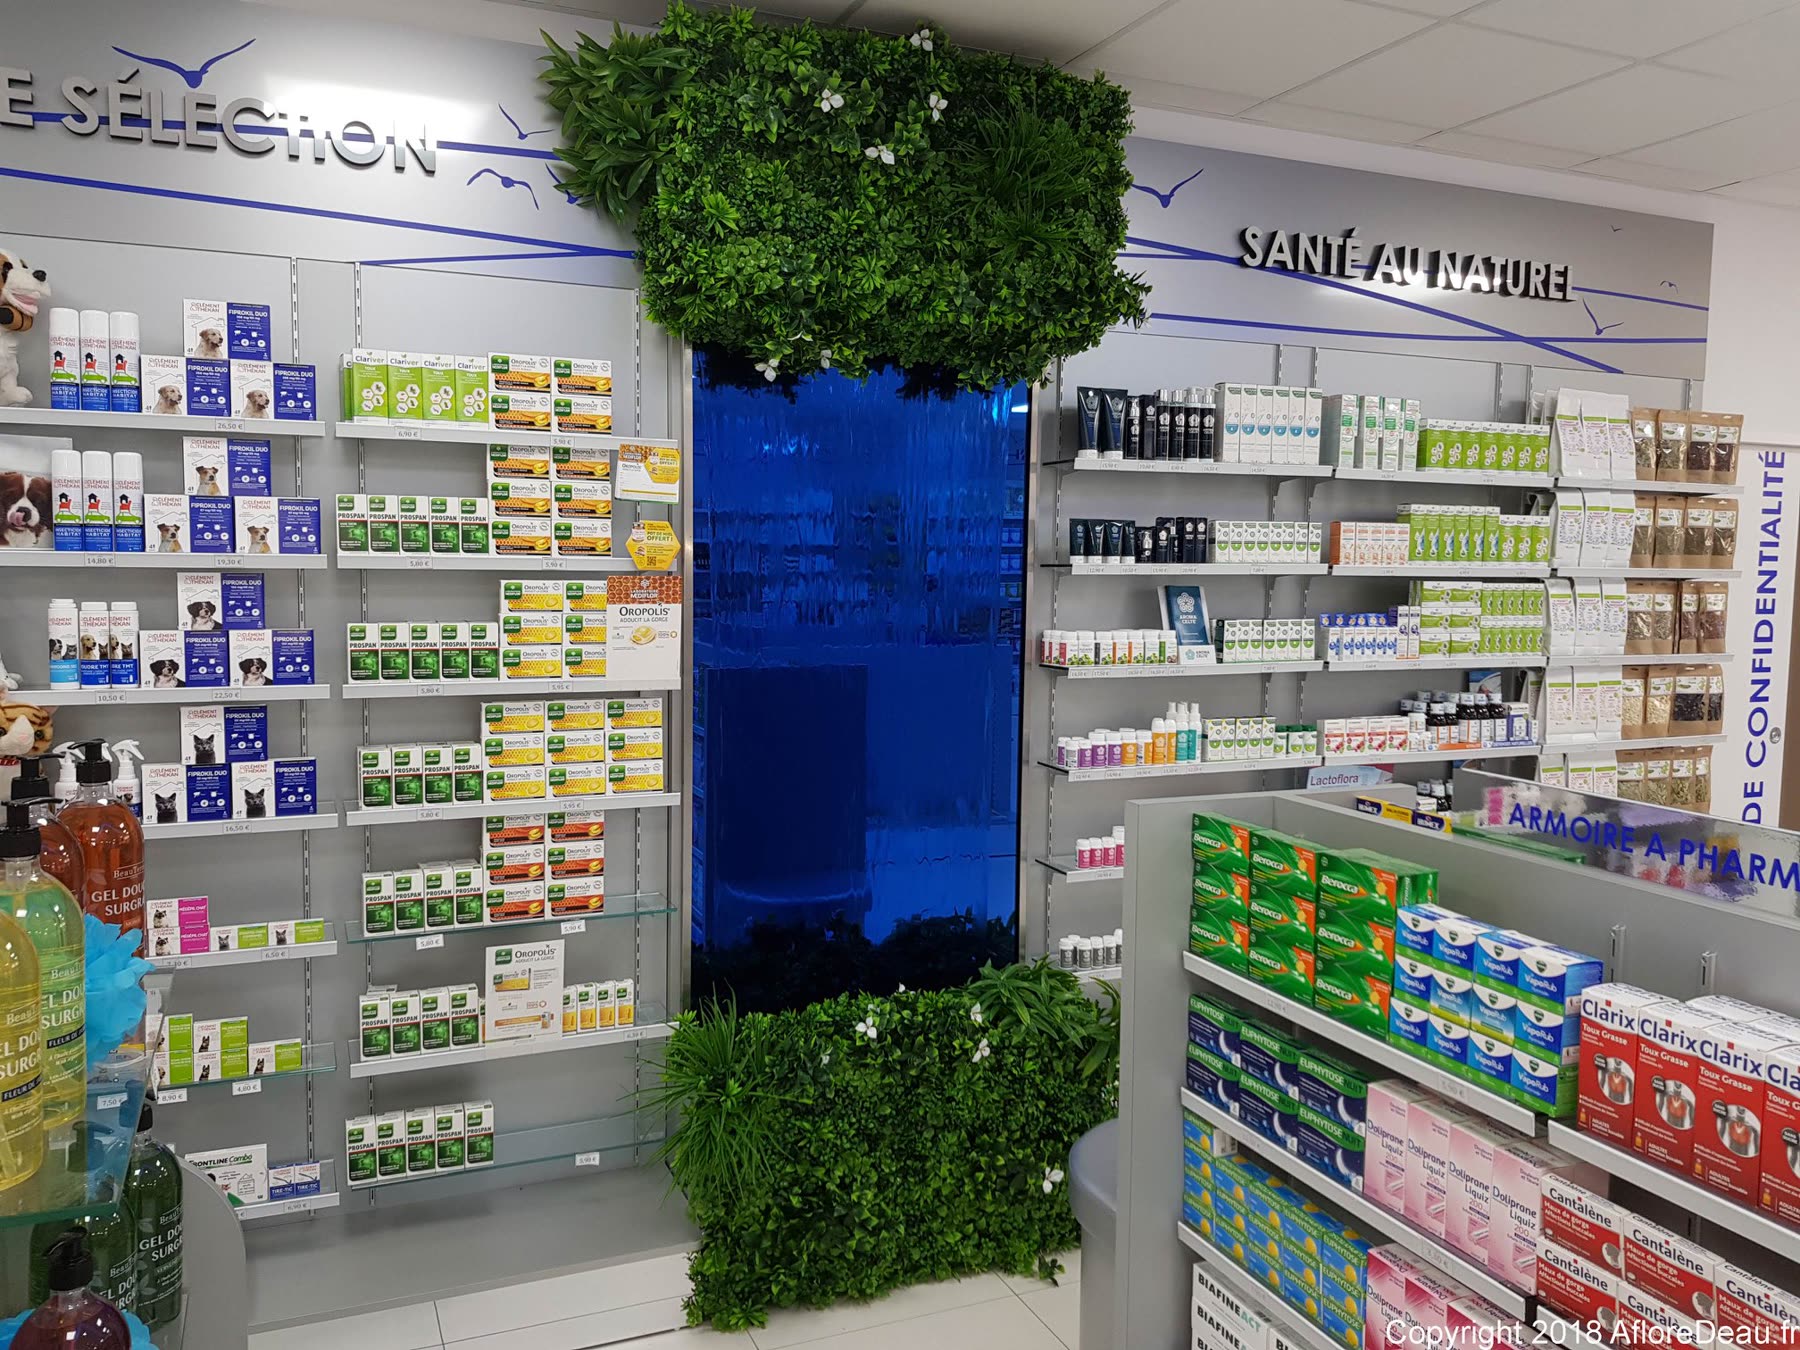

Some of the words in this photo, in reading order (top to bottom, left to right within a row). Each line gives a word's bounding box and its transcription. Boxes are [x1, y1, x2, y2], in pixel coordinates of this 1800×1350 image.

[0, 66, 35, 128] E
[60, 68, 438, 177] SÉLECTION
[1239, 226, 1364, 280] SANTÉ
[1370, 241, 1431, 287] AU
[1437, 250, 1577, 303] NATUREL
[390, 358, 419, 366] Clariver
[424, 360, 452, 368] Clariver
[457, 362, 486, 370] Clariver
[1745, 450, 1786, 768] CONFIDENTIALITÉ
[441, 641, 468, 649] PROSPAN
[470, 640, 496, 648] PROSPAN
[362, 768, 389, 776] PROSPAN
[394, 767, 421, 775] PROSPAN
[424, 766, 450, 774] PROSPAN
[454, 764, 481, 772] PROSPAN
[1310, 774, 1359, 786] Lactoflora
[1193, 833, 1221, 848] Berocca
[1509, 803, 1635, 853] ARMOIRE
[1645, 833, 1666, 862] A
[1679, 838, 1800, 893] PHARM
[1252, 853, 1284, 870] Berocca
[91, 888, 119, 902] GEL
[1195, 879, 1222, 895] Berocca
[1321, 877, 1359, 894] Berocca
[1251, 902, 1282, 921] Berocca
[1192, 925, 1220, 942] Berocca
[1318, 926, 1355, 948] Berocca
[1249, 951, 1281, 970] Berocca
[1316, 978, 1353, 1000] Berocca
[1525, 972, 1557, 993] VapoRub
[1582, 999, 1636, 1031] Clarix
[1582, 1023, 1600, 1036] Toux
[1602, 1028, 1628, 1046] Grasse
[1640, 1018, 1697, 1053] Clarix
[1640, 1043, 1659, 1057] Toux
[1661, 1051, 1689, 1068] Grasse
[1700, 1039, 1763, 1078] Clarix
[1518, 1070, 1549, 1093] VapoRub
[1700, 1066, 1720, 1080] Toux
[1721, 1073, 1753, 1092] Grasse
[1767, 1090, 1790, 1107] Toux
[1367, 1119, 1404, 1147] Doliprane
[1381, 1138, 1404, 1157] Liquiz
[1408, 1137, 1446, 1168] Doliprane
[1422, 1160, 1446, 1179] Liquiz
[1449, 1161, 1490, 1193] Doliprane
[1464, 1183, 1490, 1204] Liquiz
[1492, 1185, 1537, 1219] Doliprane
[1545, 1200, 1561, 1213] Maux
[1562, 1209, 1570, 1219] de
[1550, 1187, 1612, 1228] Cantalène
[1509, 1209, 1536, 1230] Liquiz
[139, 1235, 164, 1250] GEL
[1633, 1229, 1704, 1275] Cantalène
[1626, 1242, 1645, 1258] Maux
[1647, 1253, 1656, 1263] de
[1657, 1262, 1678, 1276] gorge
[1544, 1249, 1608, 1292] Cantalène
[1367, 1283, 1402, 1318] Doliprane
